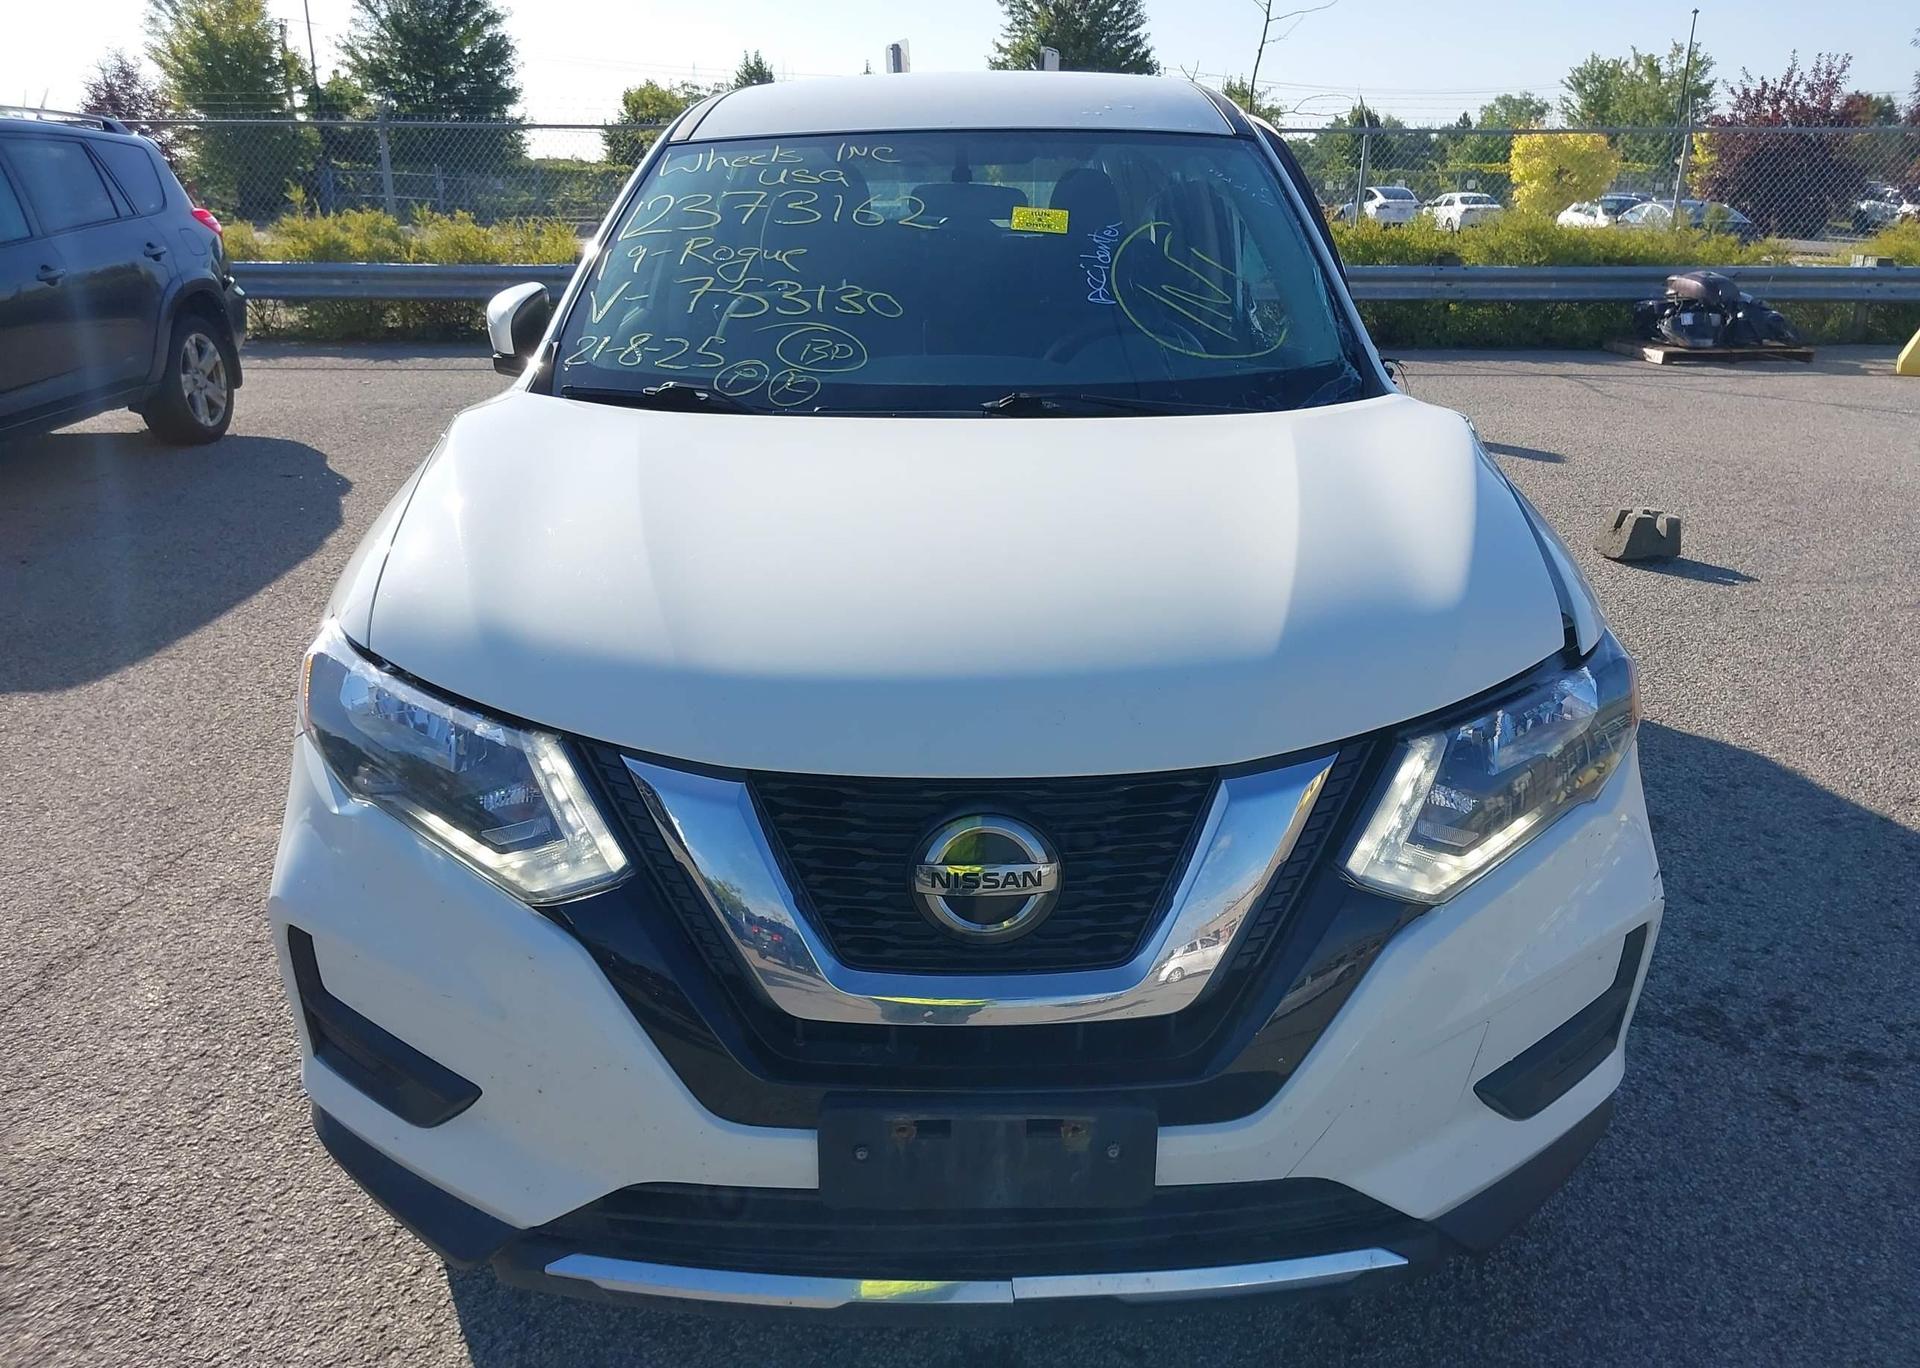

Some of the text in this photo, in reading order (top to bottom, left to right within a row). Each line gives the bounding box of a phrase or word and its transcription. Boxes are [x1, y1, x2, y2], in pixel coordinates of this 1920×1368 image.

[837, 143, 900, 161] INC
[564, 333, 726, 369] 21-8-25
[931, 870, 1042, 889] NISSAN
